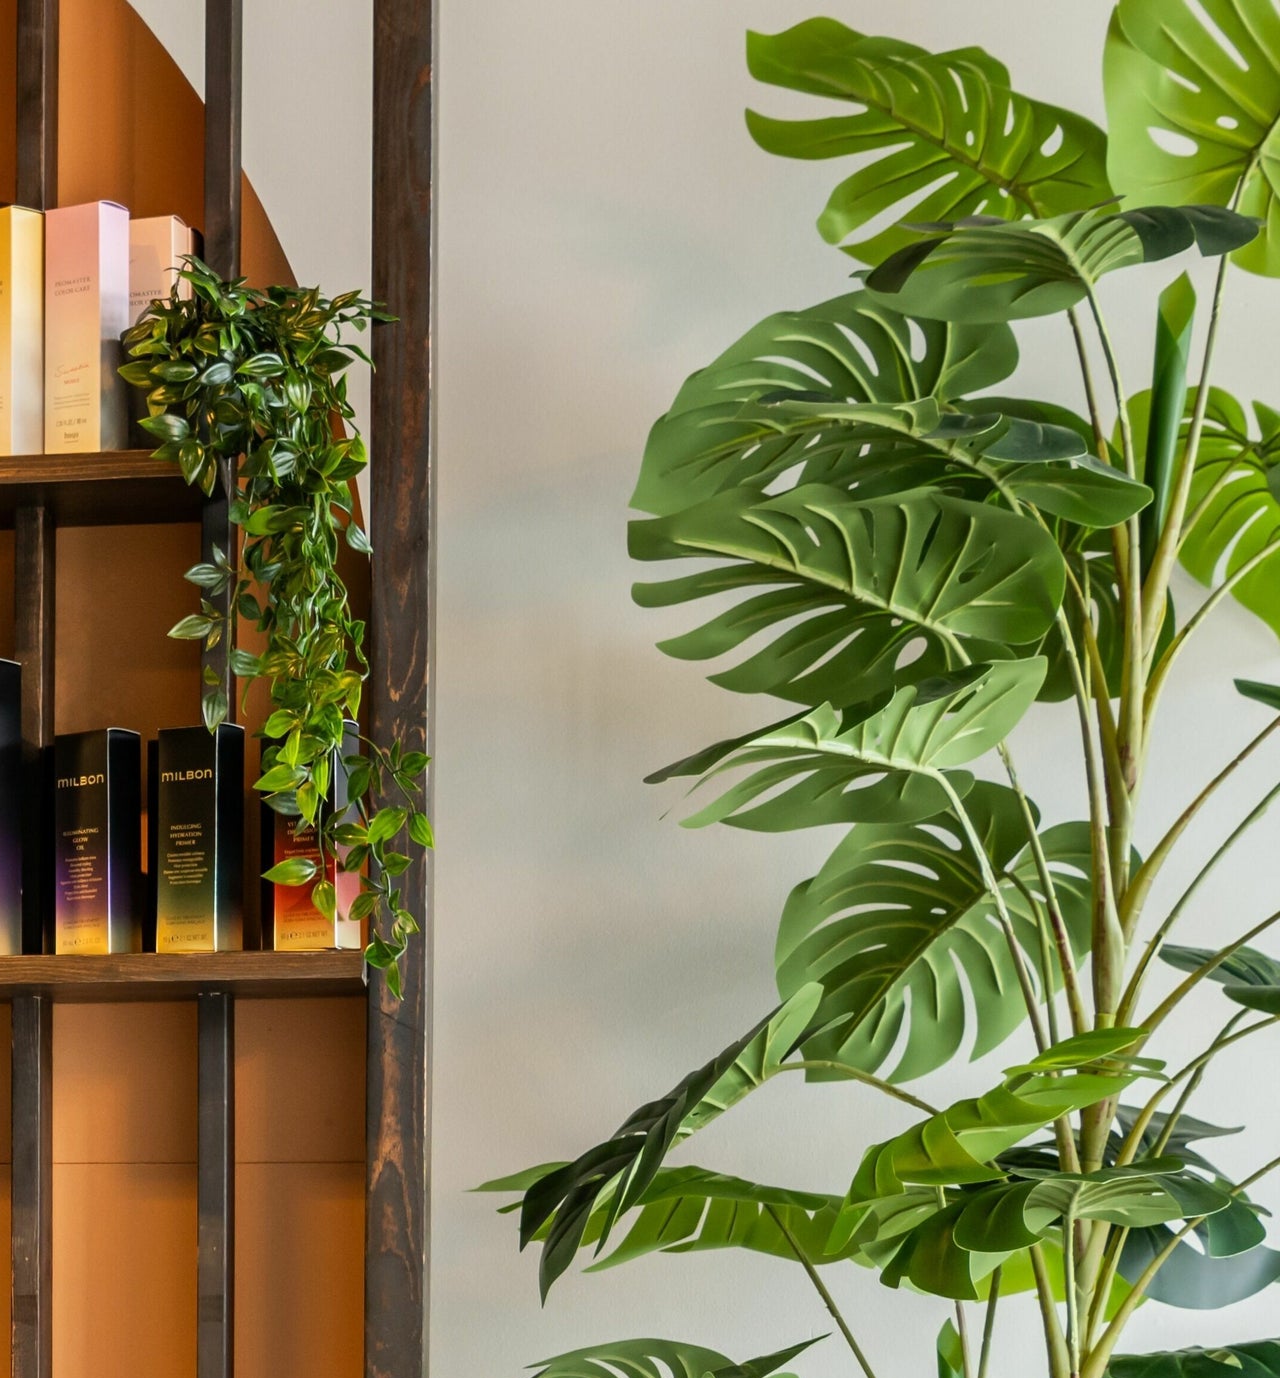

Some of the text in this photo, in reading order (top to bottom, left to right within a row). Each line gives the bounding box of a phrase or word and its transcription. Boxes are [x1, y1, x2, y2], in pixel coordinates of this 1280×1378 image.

[55, 277, 90, 287] PROMASTER
[54, 288, 73, 296] COLOR
[58, 773, 104, 788] MILBON
[162, 769, 212, 782] MILBON
